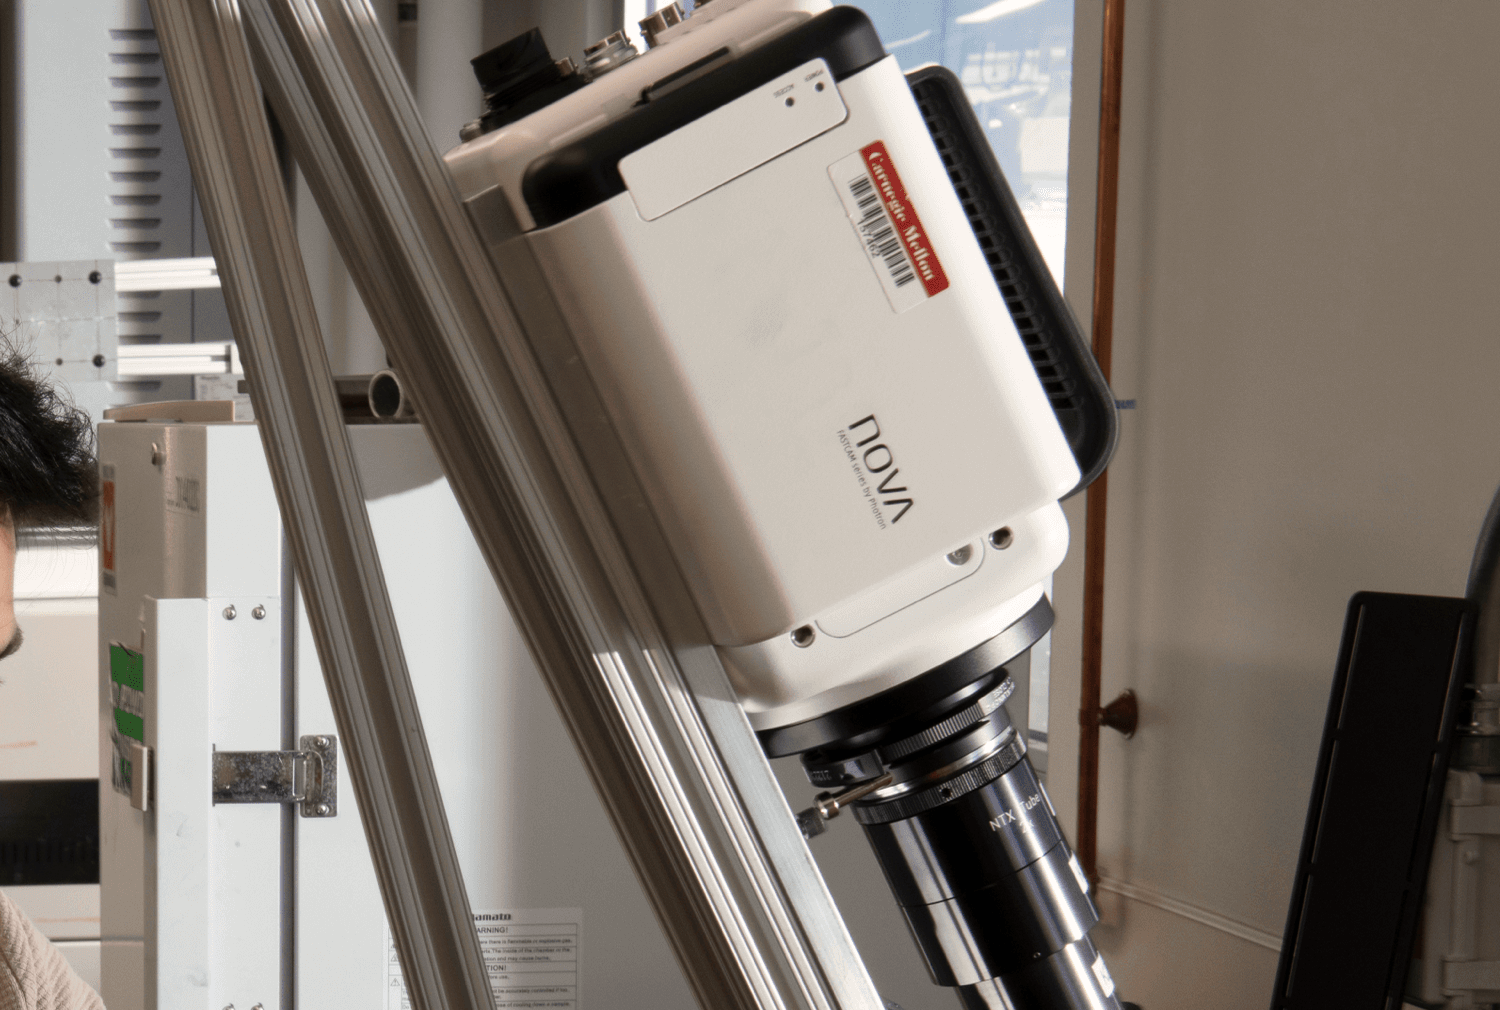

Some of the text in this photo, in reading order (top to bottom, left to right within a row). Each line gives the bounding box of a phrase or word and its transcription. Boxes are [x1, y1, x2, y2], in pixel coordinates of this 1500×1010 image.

[803, 69, 824, 83] POWER
[773, 83, 795, 98] ACCESS
[867, 151, 935, 282] Carnegie Mellon
[857, 218, 882, 259] 157462
[836, 429, 887, 530] FASTCAM series by Photron
[988, 792, 1041, 832] NTX Tube
[472, 913, 512, 921] amato
[476, 926, 509, 934] ARNING!
